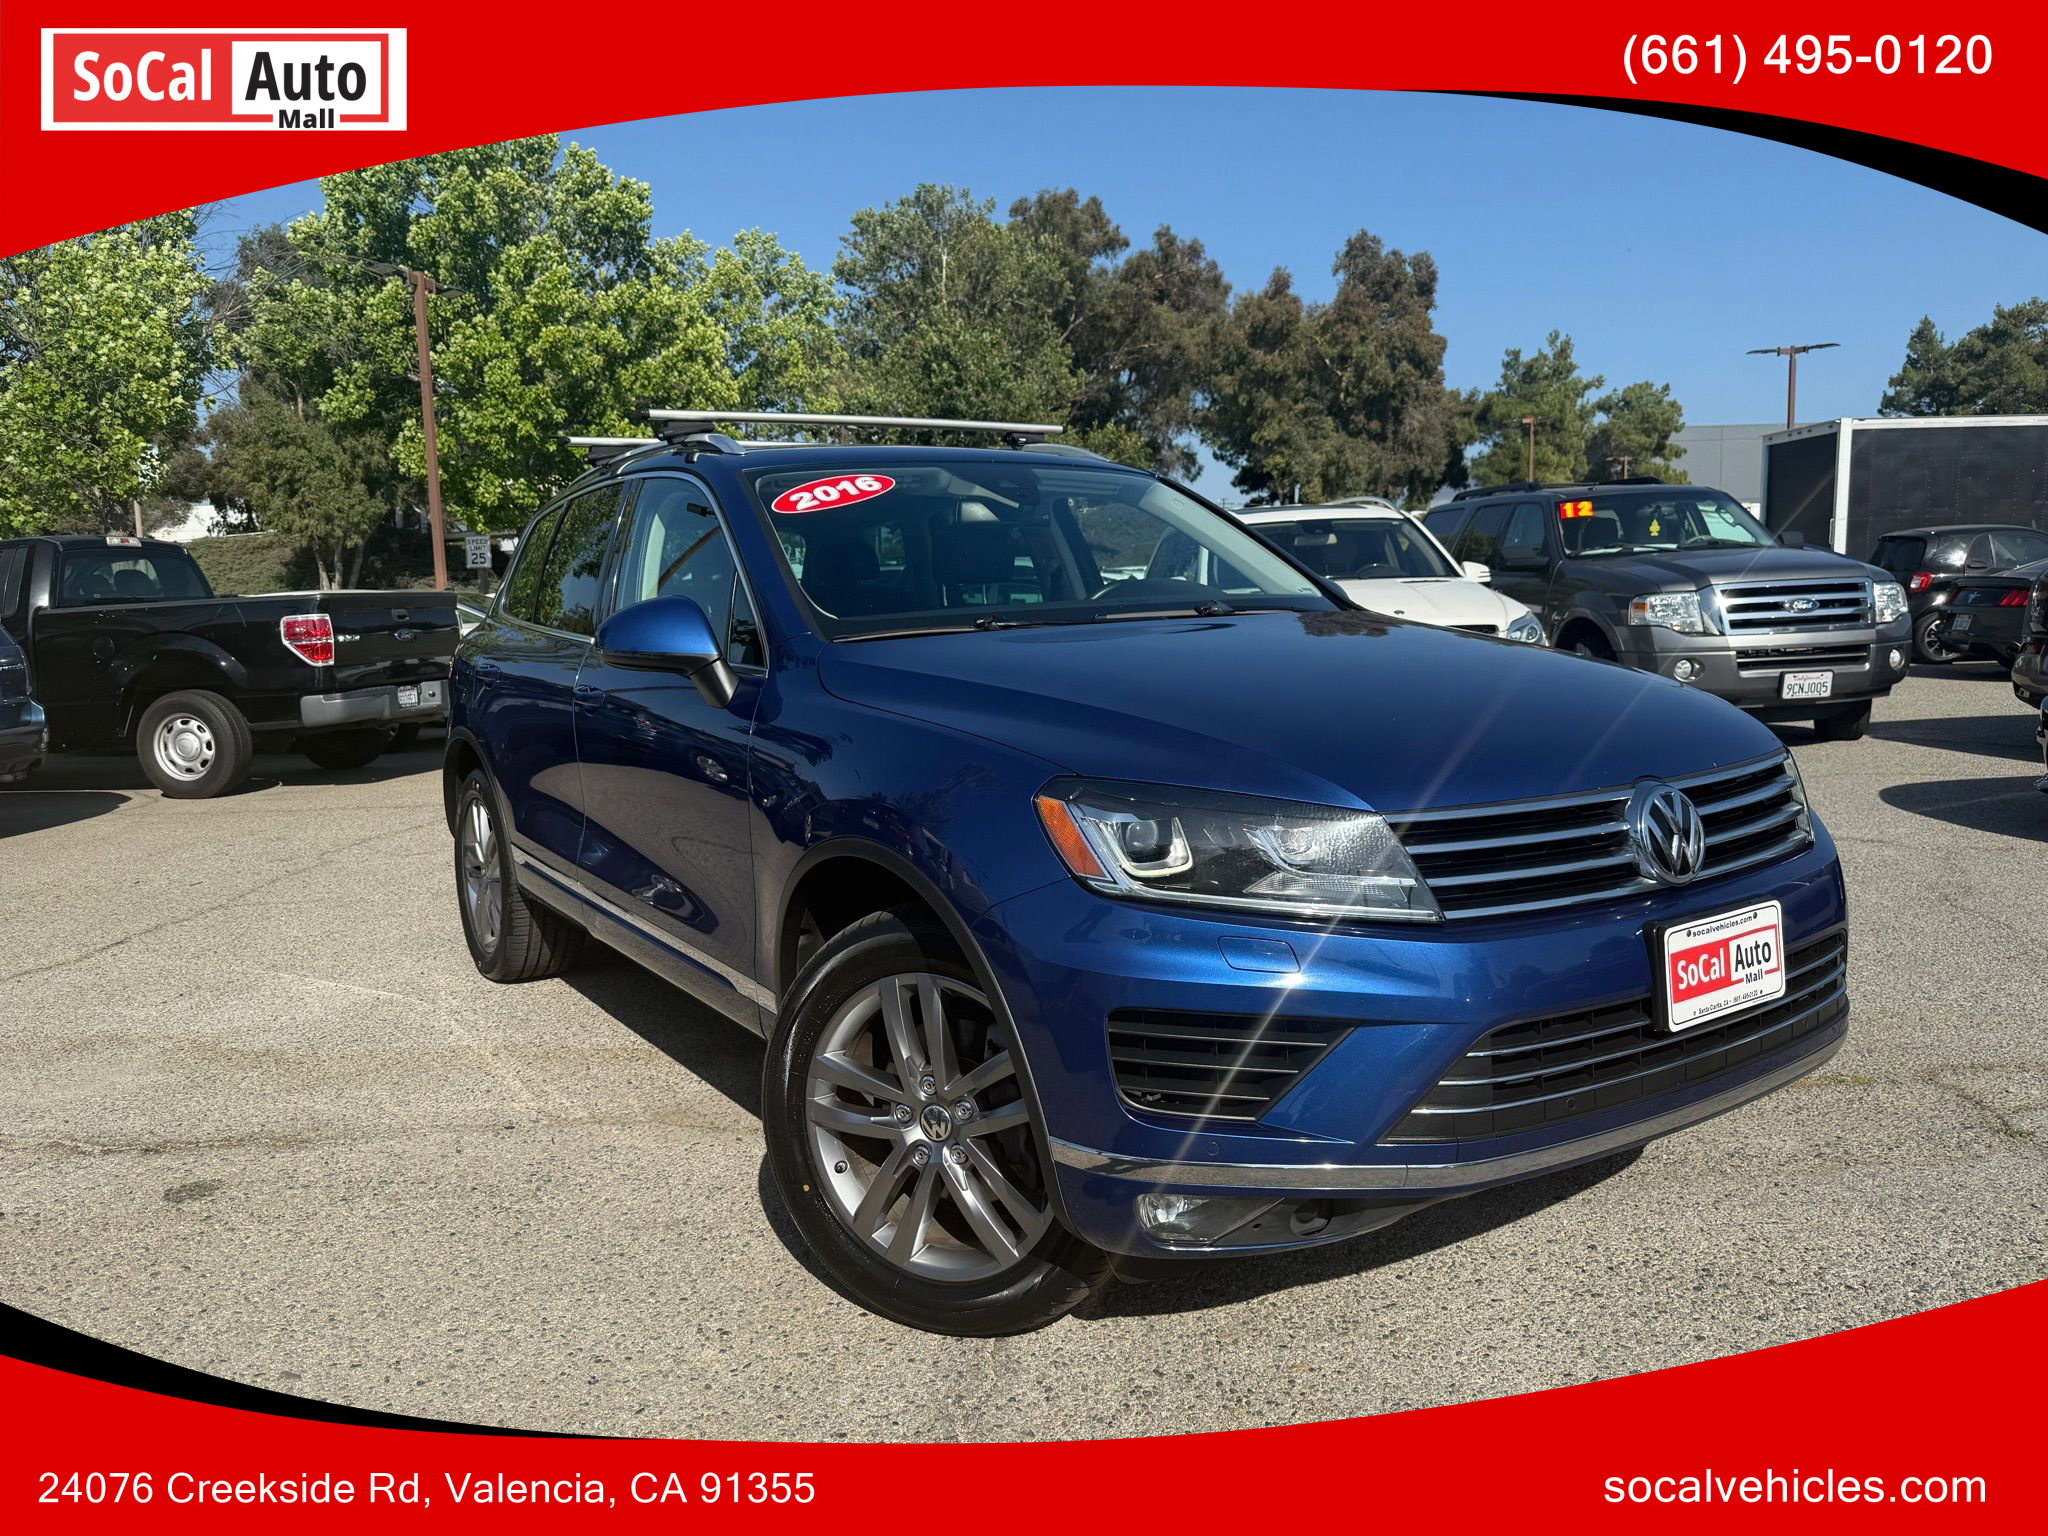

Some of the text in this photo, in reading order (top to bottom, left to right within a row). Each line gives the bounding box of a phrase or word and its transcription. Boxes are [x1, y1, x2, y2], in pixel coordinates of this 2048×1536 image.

[789, 477, 882, 511] 2016
[1563, 501, 1592, 517] 12
[472, 553, 486, 564] 25
[1692, 915, 1752, 937] socalvehicles.com
[1677, 940, 1772, 990] SoCal Auto
[1745, 969, 1763, 984] Mall
